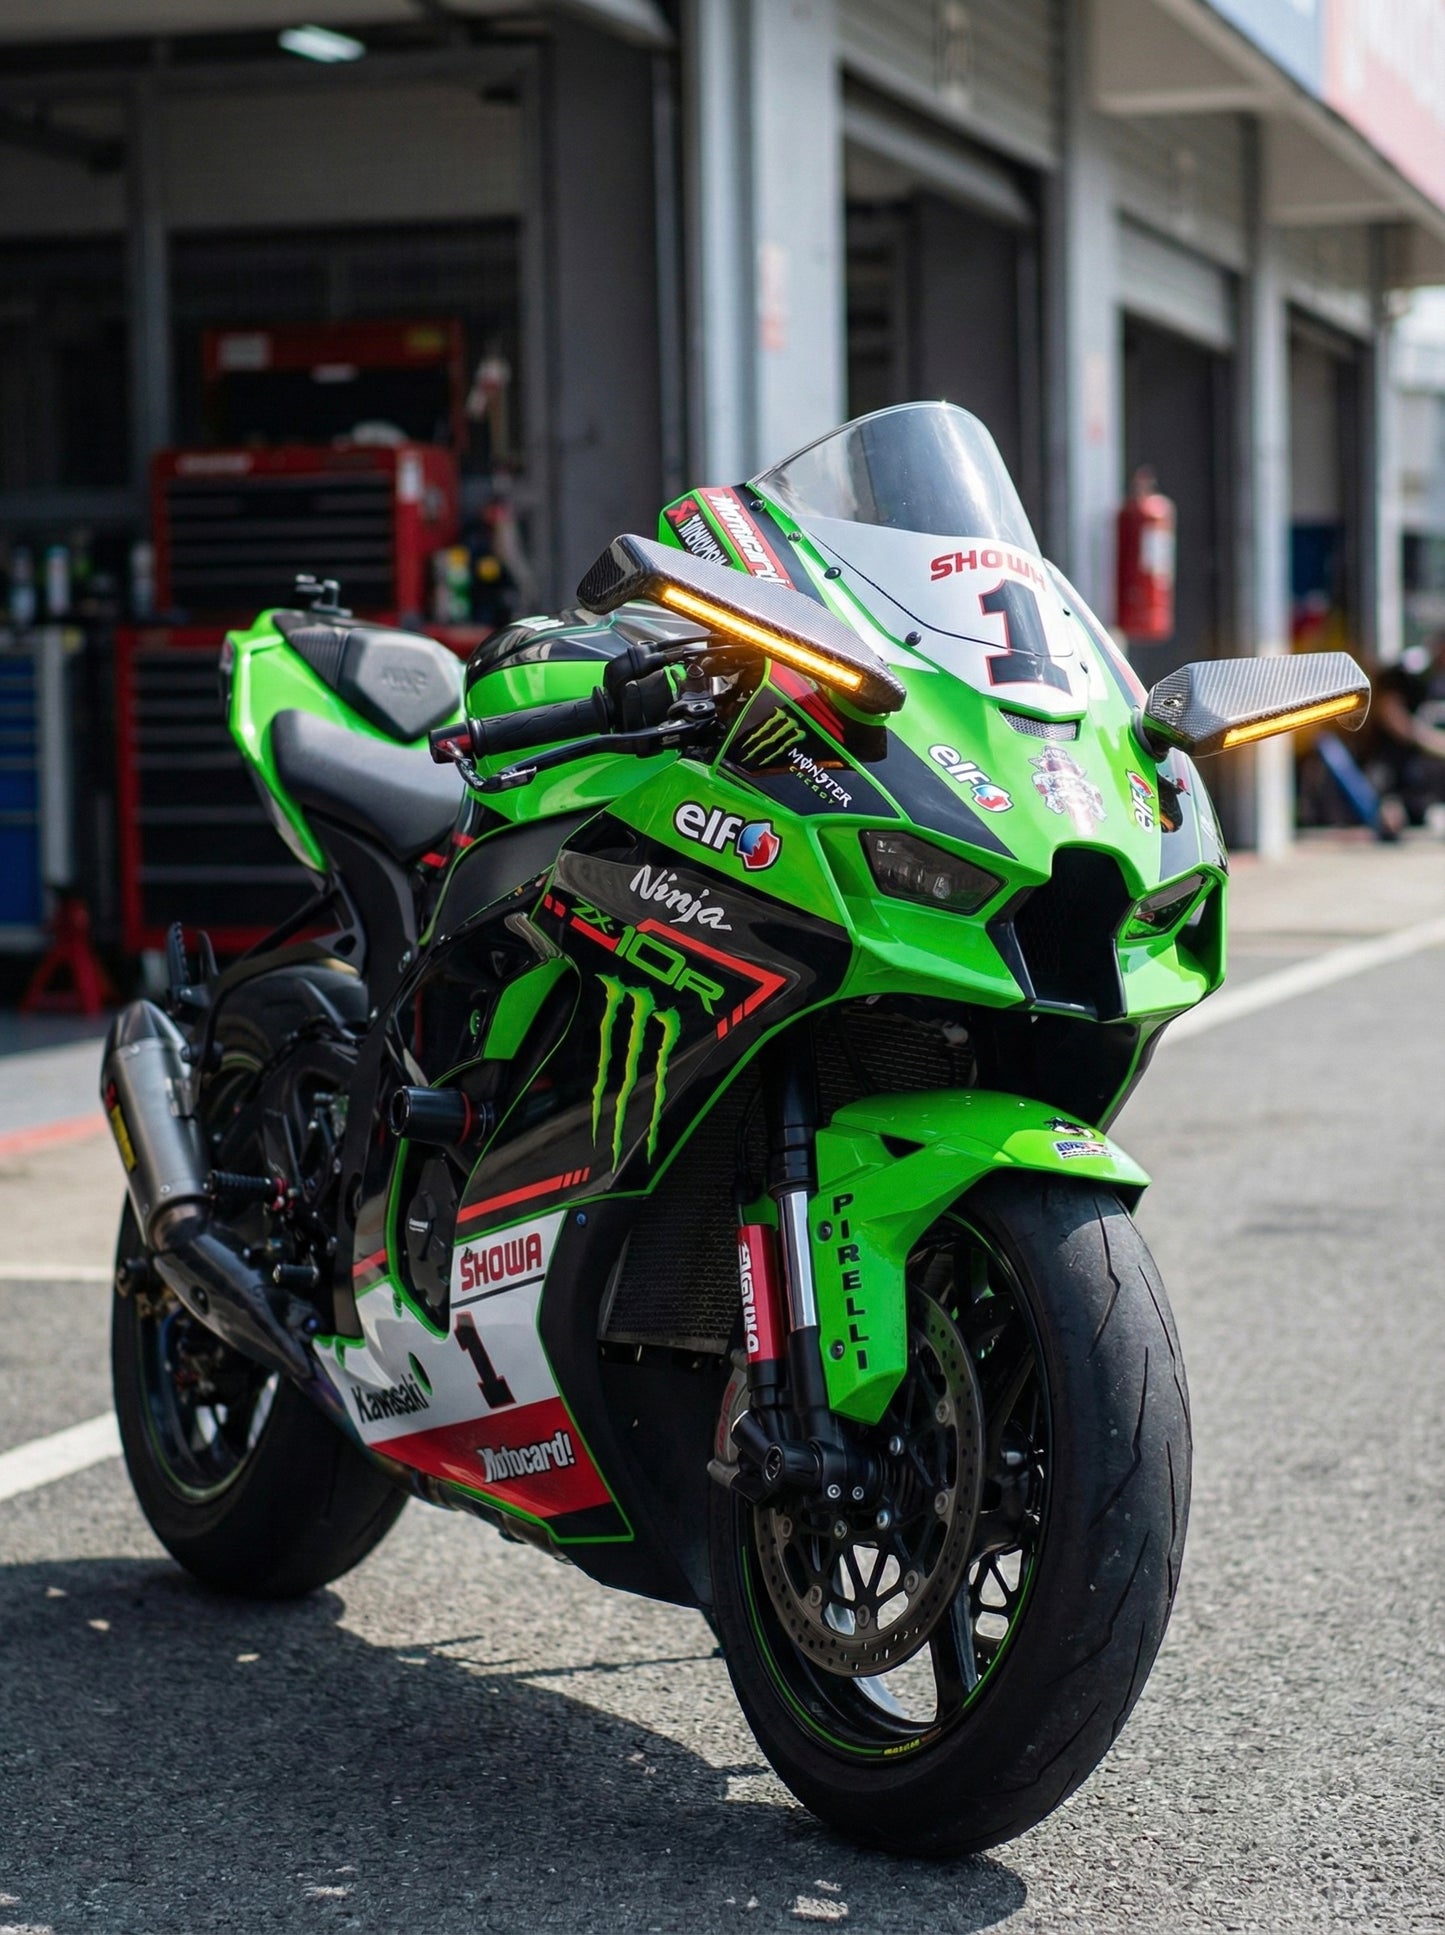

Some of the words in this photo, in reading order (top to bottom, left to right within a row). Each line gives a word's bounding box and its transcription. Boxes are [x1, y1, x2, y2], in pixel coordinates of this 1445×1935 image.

[978, 578, 1073, 697] 1
[787, 747, 853, 808] MONSTER
[674, 803, 743, 851] elf
[629, 864, 733, 932] Ninja
[459, 1232, 543, 1292] SHOWA
[832, 1192, 869, 1371] PIRELLI
[453, 1309, 517, 1410] 1
[350, 1372, 431, 1425] Kawasaki
[476, 1431, 576, 1485] Motocard!
